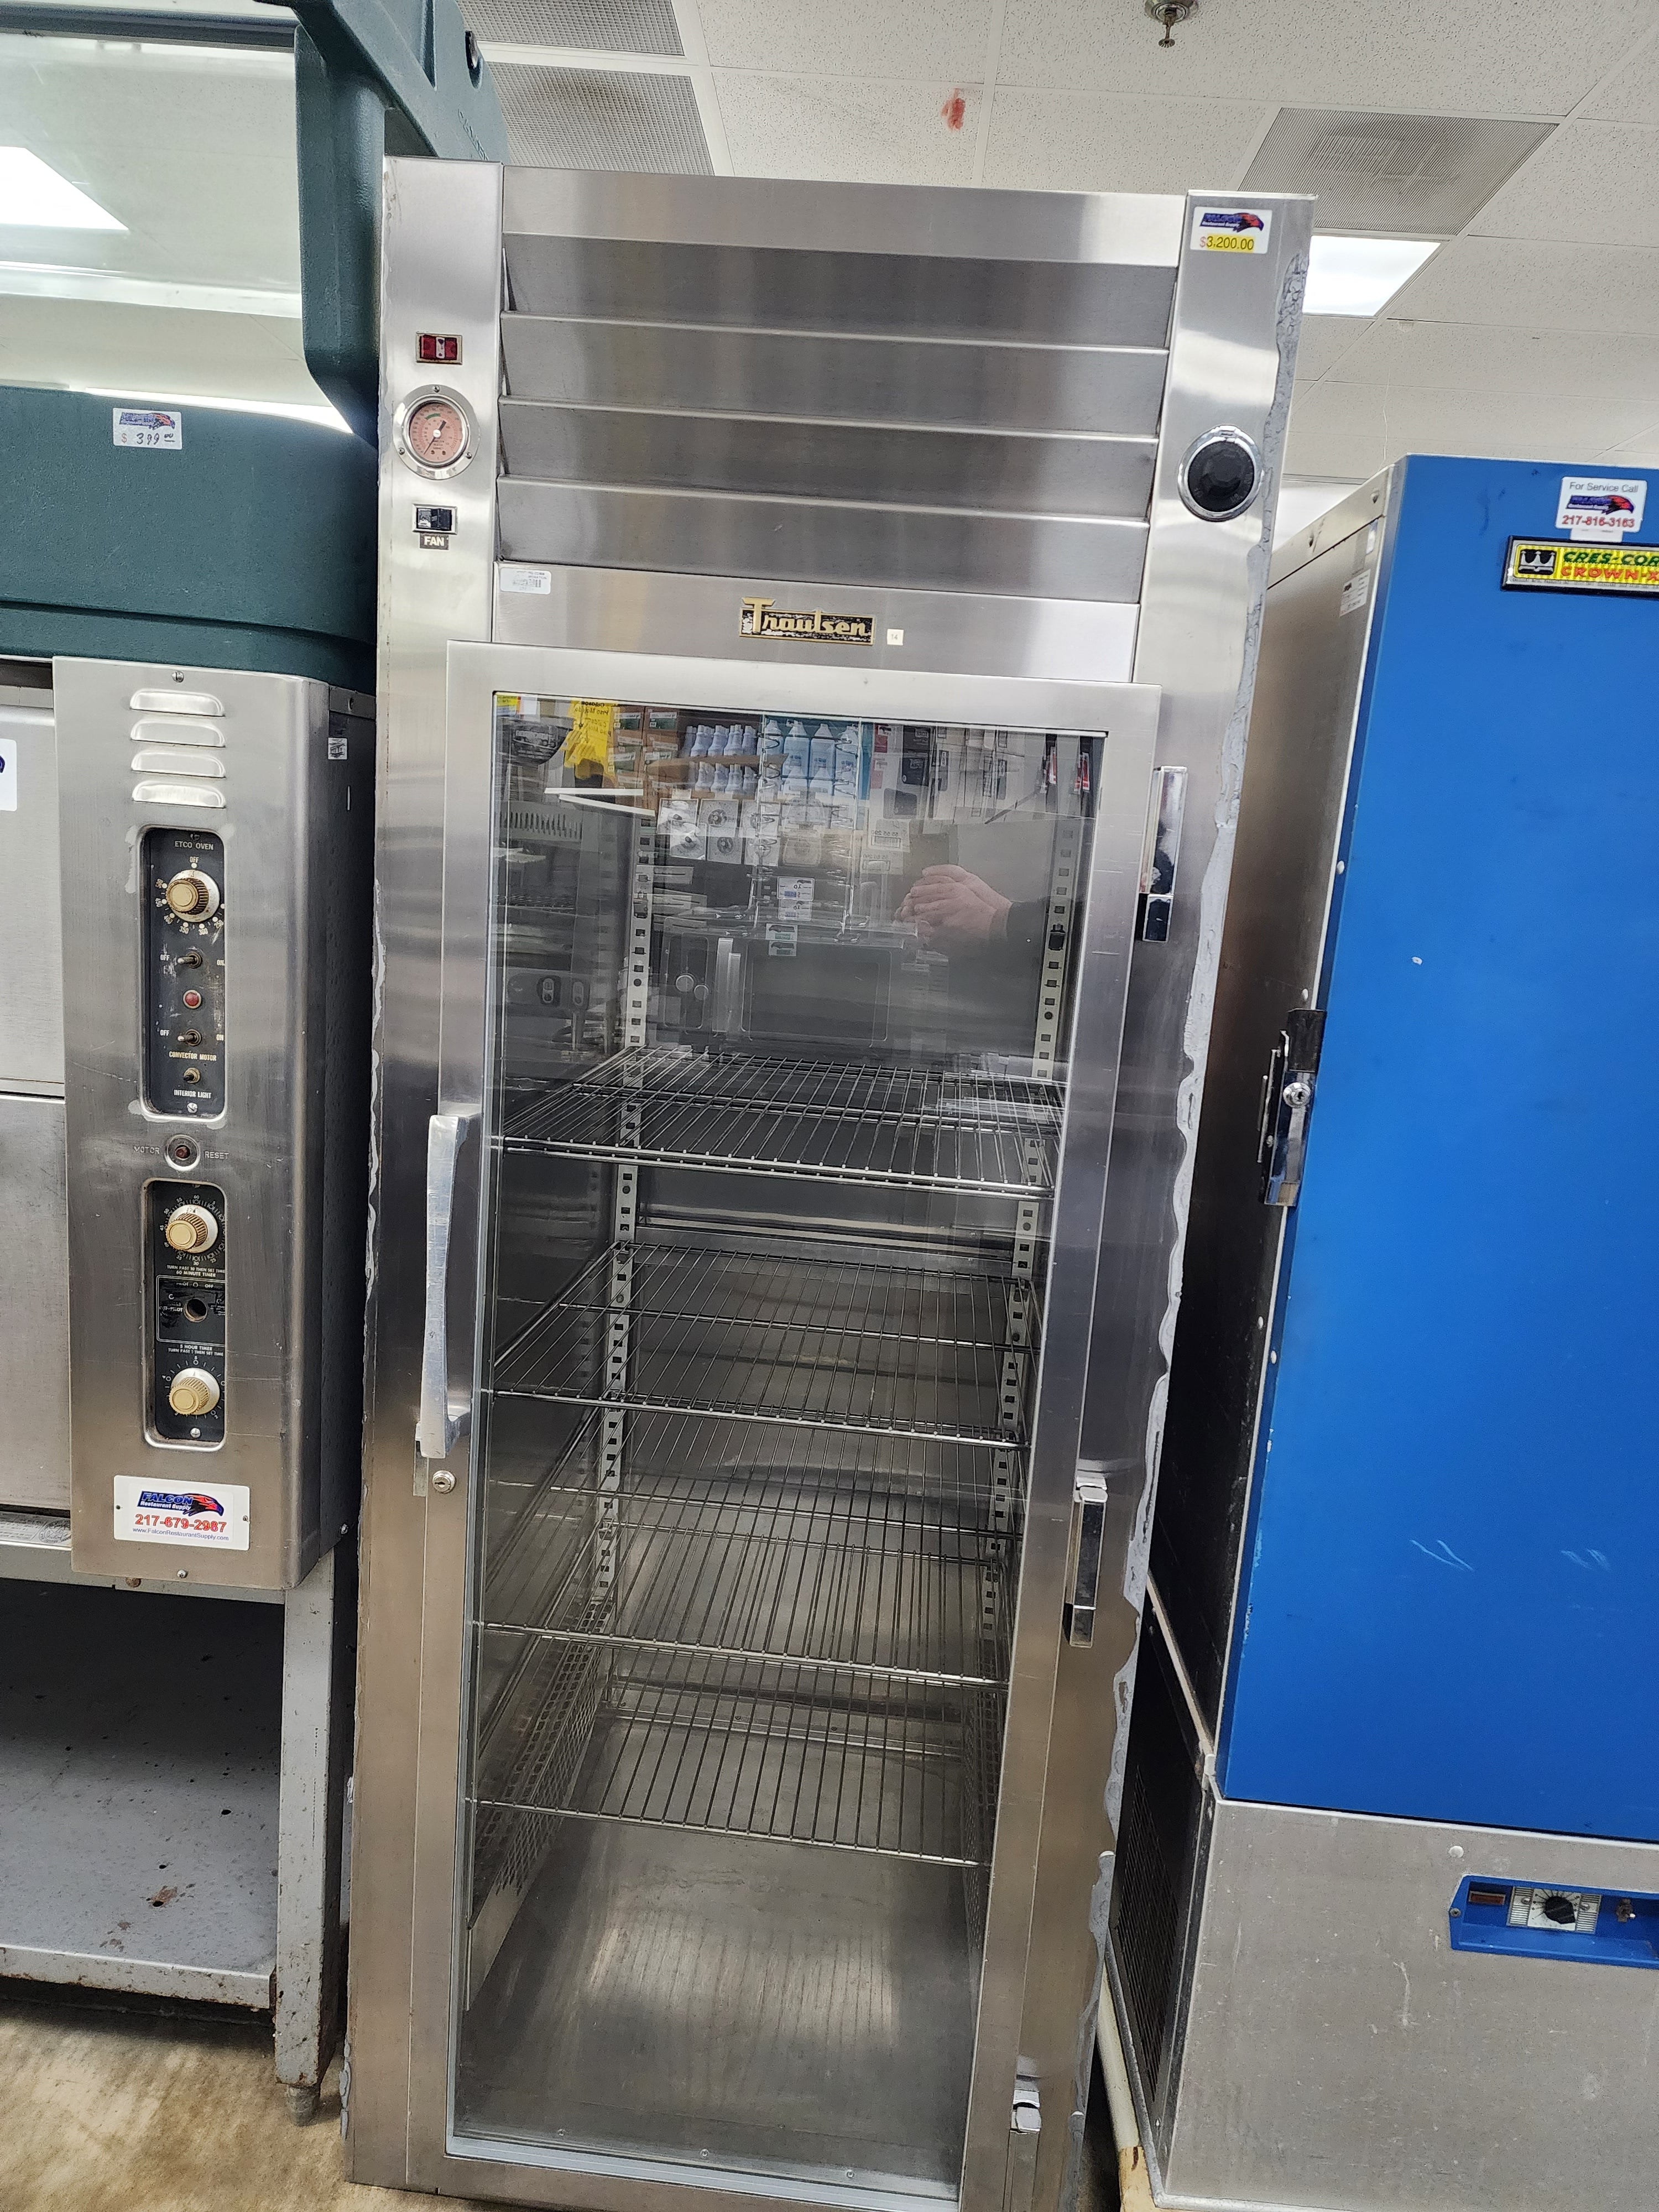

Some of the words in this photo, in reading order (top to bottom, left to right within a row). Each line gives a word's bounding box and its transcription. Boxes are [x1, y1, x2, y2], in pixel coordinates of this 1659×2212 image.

[1569, 482, 1584, 490] For
[1587, 483, 1619, 492] Service
[1621, 484, 1639, 493] Call
[424, 536, 445, 546] FAN
[743, 597, 868, 636] Traulsen
[155, 878, 164, 889] 500
[214, 920, 224, 928] 250
[179, 926, 189, 934] 350
[169, 1051, 197, 1060] CONVECTOR
[205, 1151, 229, 1160] RESET
[142, 1493, 194, 1505] FALCON
[135, 1514, 227, 1532] 217-679-2987
[133, 1527, 229, 1541] www.FalconRestaurantSupply.com
